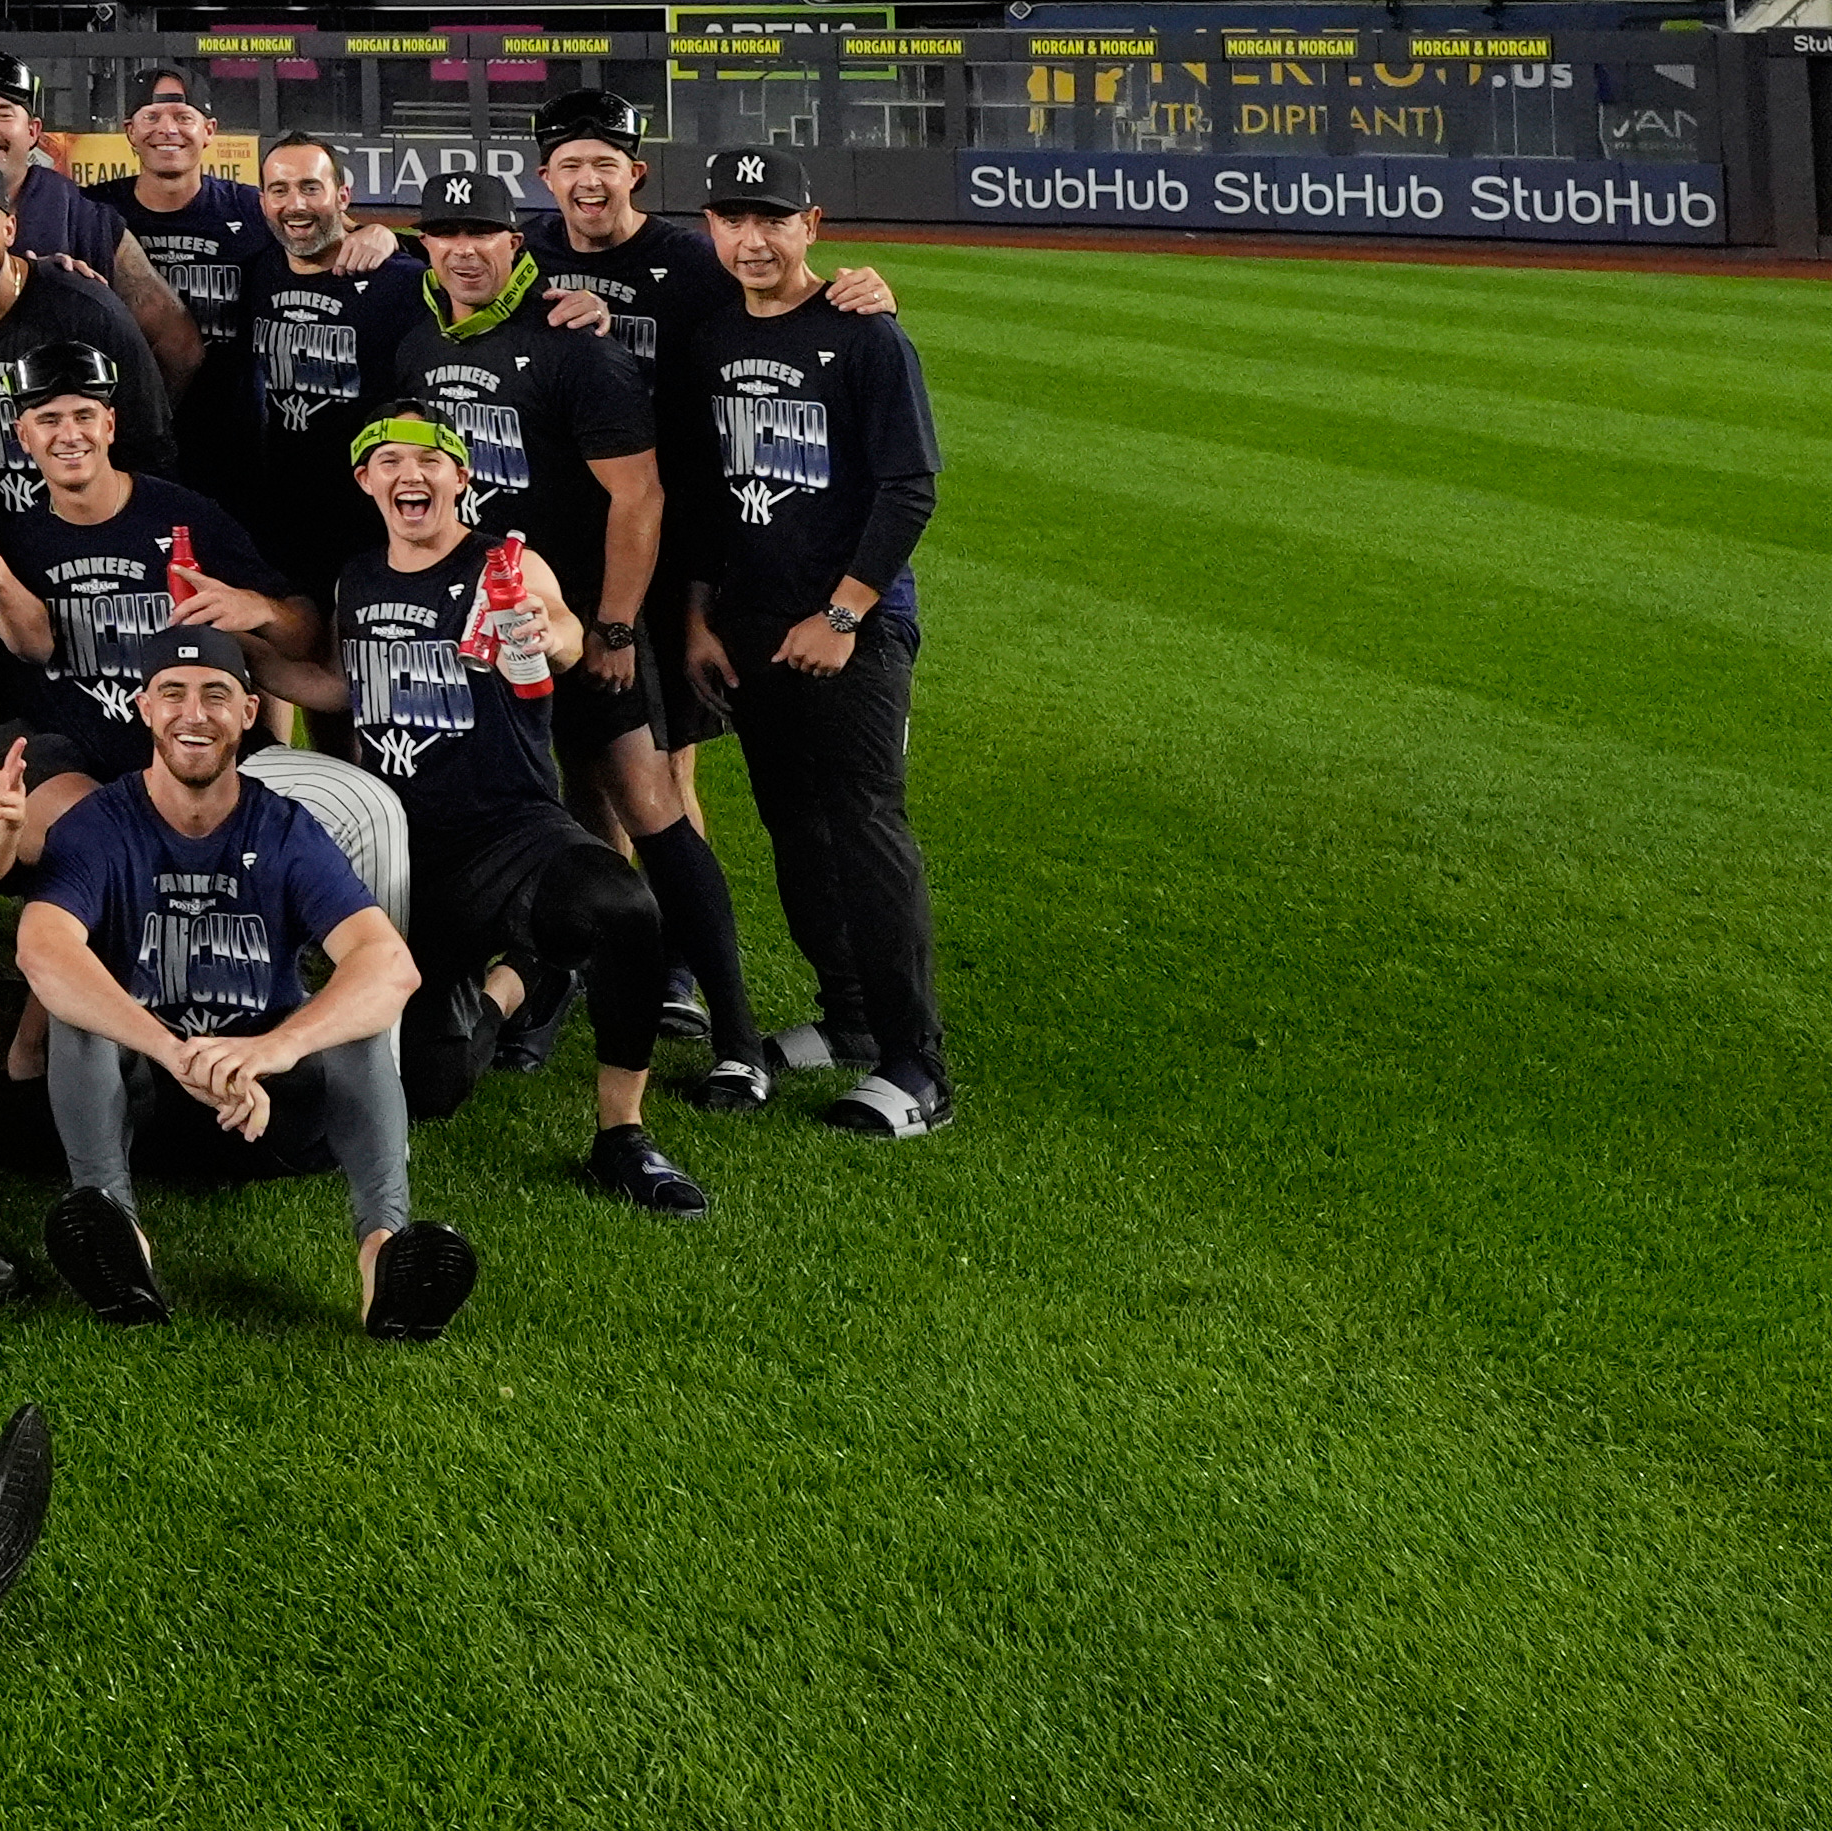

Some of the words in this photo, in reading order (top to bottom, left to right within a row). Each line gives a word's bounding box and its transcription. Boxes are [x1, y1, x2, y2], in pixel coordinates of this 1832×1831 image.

[198, 38, 238, 52] MORGAN
[240, 39, 249, 52] &
[250, 39, 293, 52] MORGAN
[347, 38, 390, 52] MORGAN
[392, 39, 401, 52] &
[402, 39, 447, 53] MORGAN
[670, 39, 719, 54] MORGAN
[720, 40, 730, 54] &
[731, 40, 781, 55] MORGAN
[1031, 40, 1084, 56] MORGAN
[1087, 41, 1098, 56] &
[1099, 41, 1155, 56] MORGAN
[1227, 40, 1283, 56] MORGAN
[1285, 41, 1296, 56] &
[1297, 41, 1355, 56] MORGAN
[1412, 41, 1470, 56] MORGAN
[1473, 42, 1484, 56] &
[1487, 42, 1547, 57] MORGAN
[969, 165, 1189, 212] StubHub
[1213, 169, 1444, 221] StubHub
[1471, 174, 1718, 228] StubHub
[43, 555, 147, 585] YANKEES
